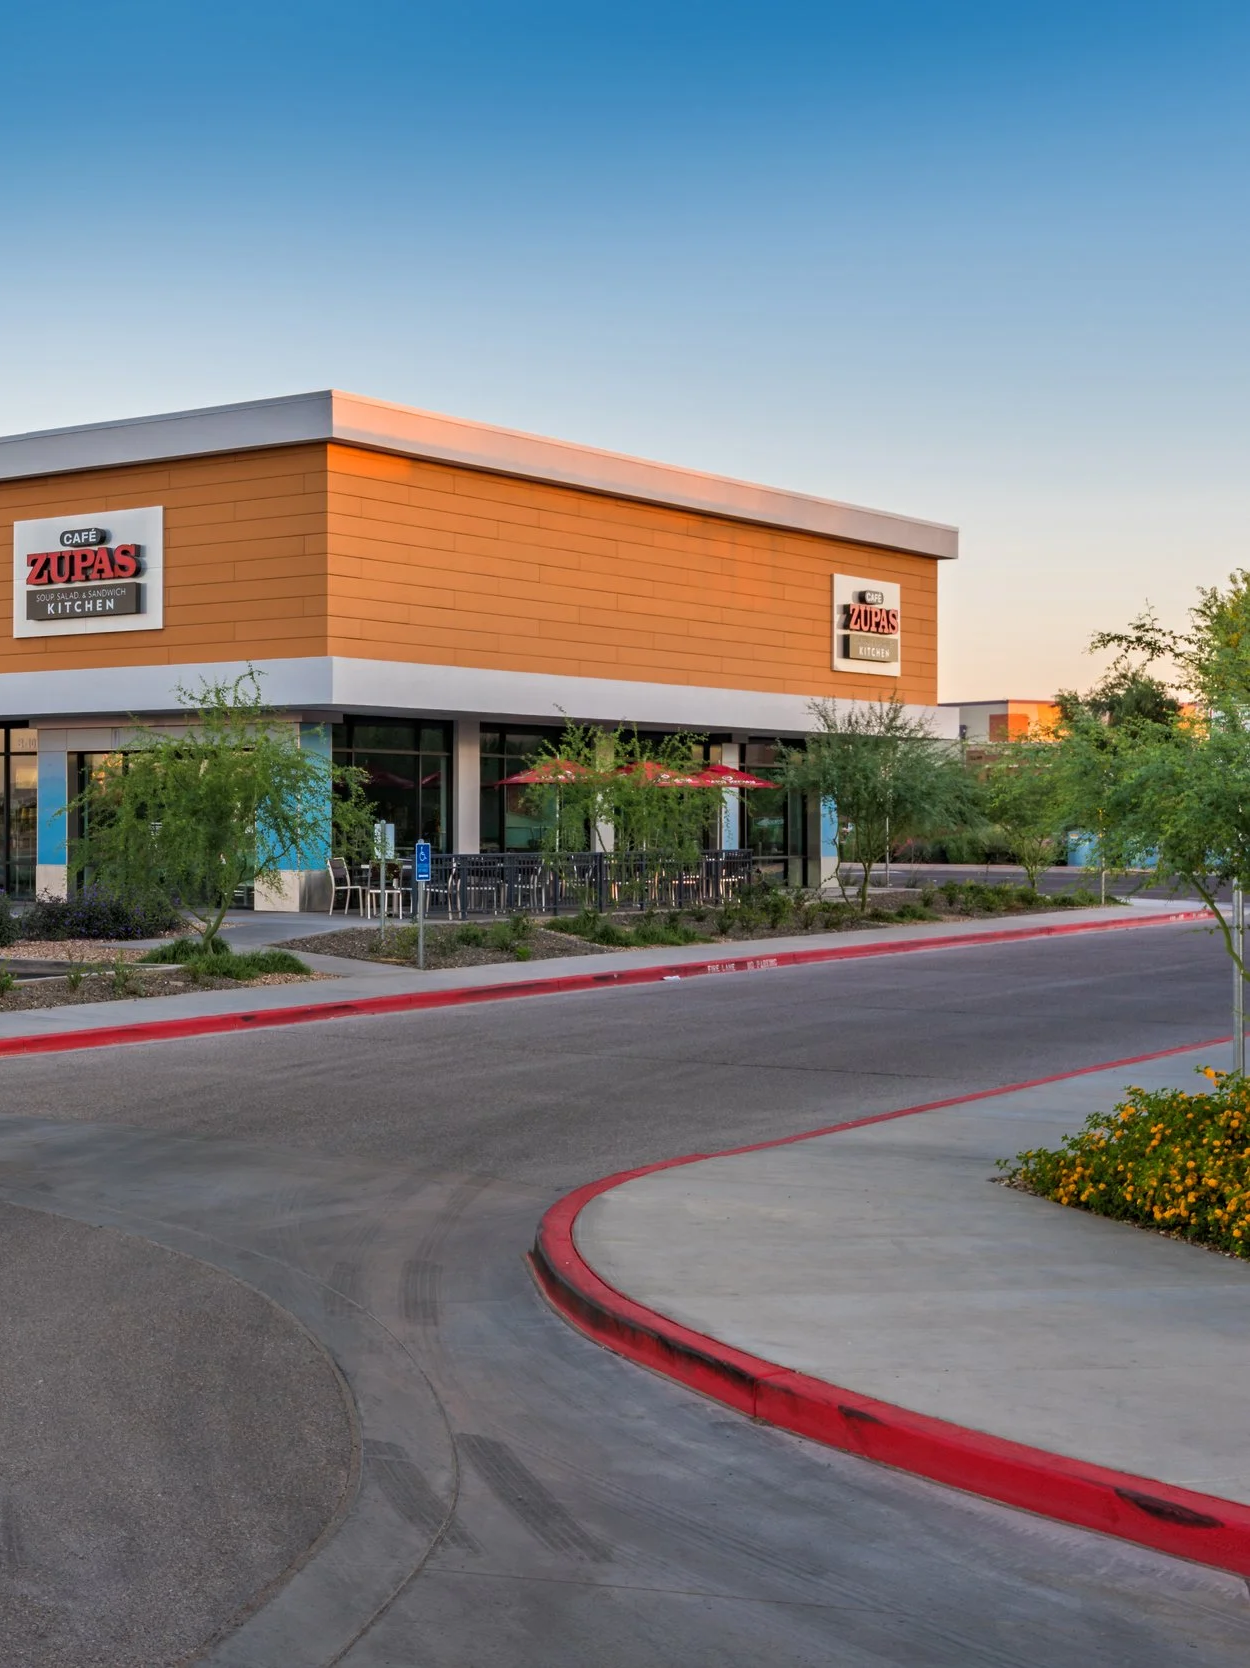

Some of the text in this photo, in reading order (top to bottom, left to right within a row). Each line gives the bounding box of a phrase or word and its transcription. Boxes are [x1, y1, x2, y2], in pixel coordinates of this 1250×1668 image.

[63, 528, 97, 545] CAFÉ
[26, 544, 138, 585] ZUPAS
[82, 591, 87, 599] &
[88, 588, 126, 598] SANDWICH
[47, 598, 114, 615] KITCHEN
[849, 604, 899, 634] ZUPAS
[858, 646, 890, 658] KITCHEN
[707, 964, 719, 973] FIRE
[721, 963, 736, 972] LANE
